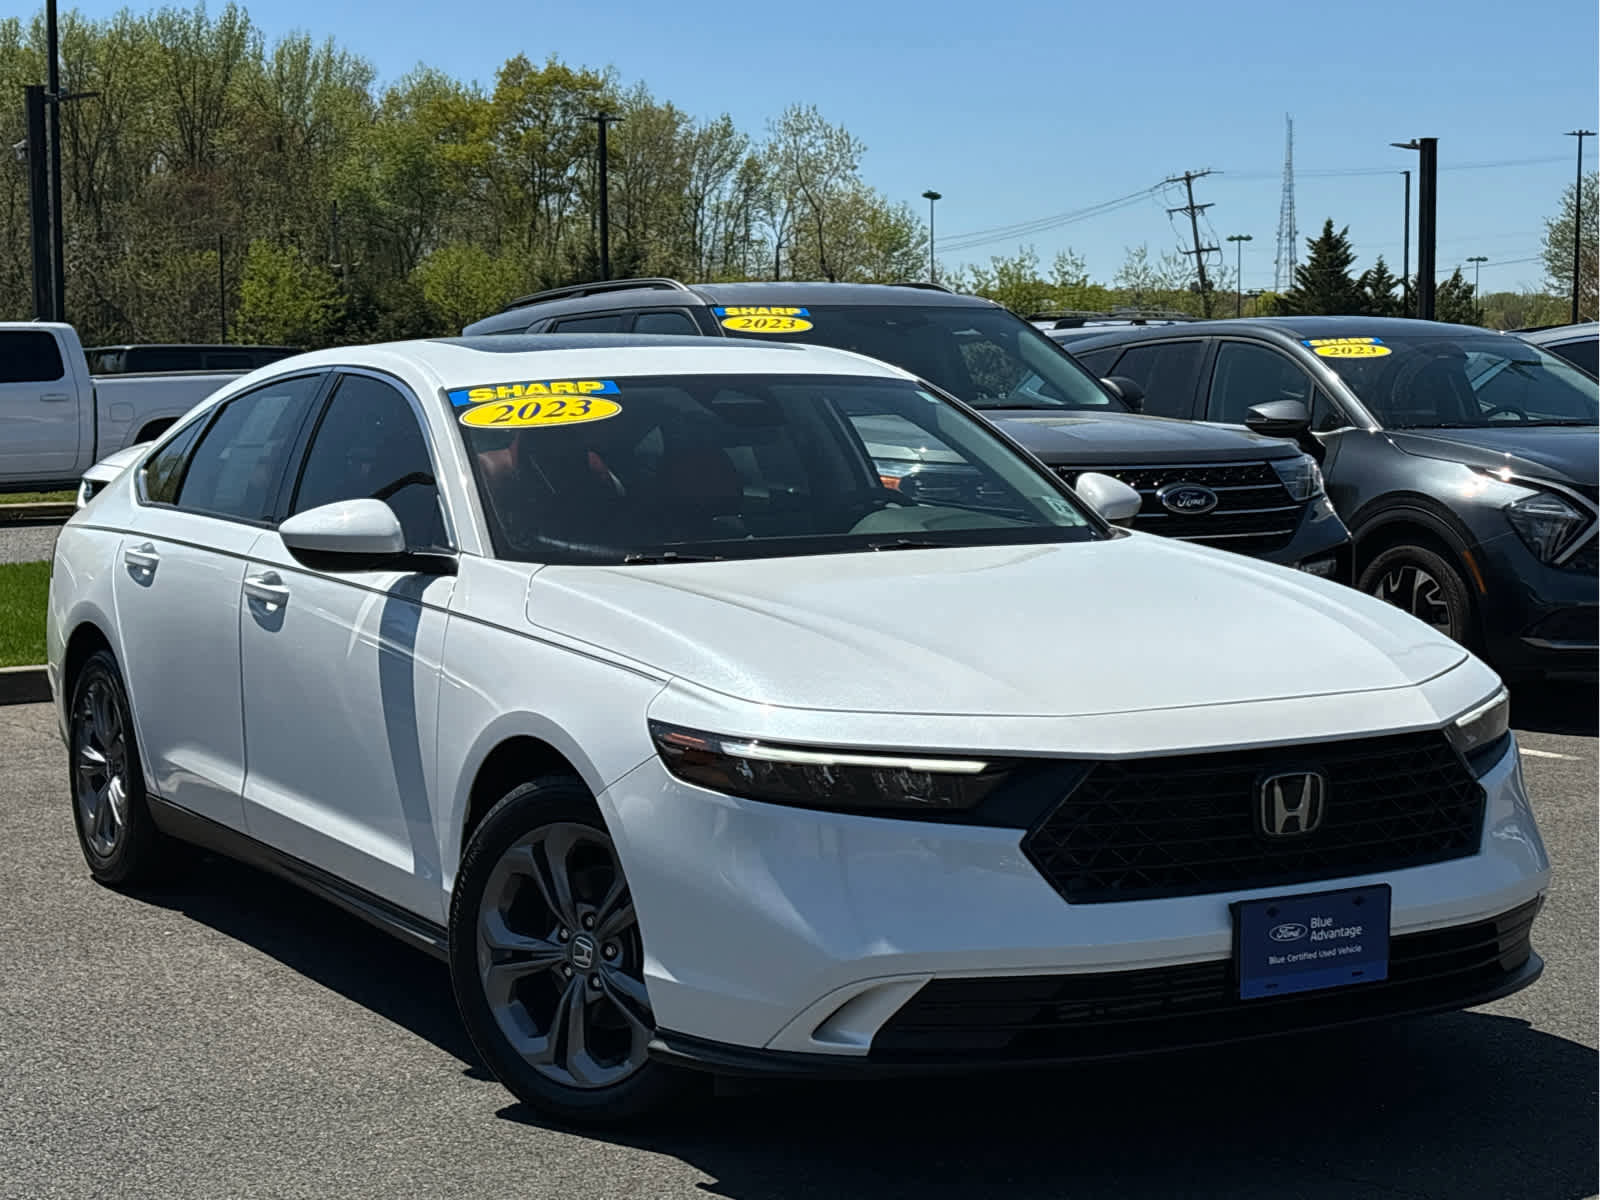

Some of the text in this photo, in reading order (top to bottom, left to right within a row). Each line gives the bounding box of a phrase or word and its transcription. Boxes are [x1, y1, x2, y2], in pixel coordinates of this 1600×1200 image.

[724, 307, 801, 316] SHARP
[739, 318, 796, 329] 2023
[1328, 346, 1377, 356] 2023
[468, 381, 605, 402] SHARP
[490, 400, 592, 424] 2023
[1177, 491, 1206, 507] Ford
[1310, 916, 1333, 929] Blue
[1276, 925, 1301, 939] Ford
[1310, 925, 1363, 943] Advantage
[1268, 944, 1363, 965] Blue Certified Used Vehicle
